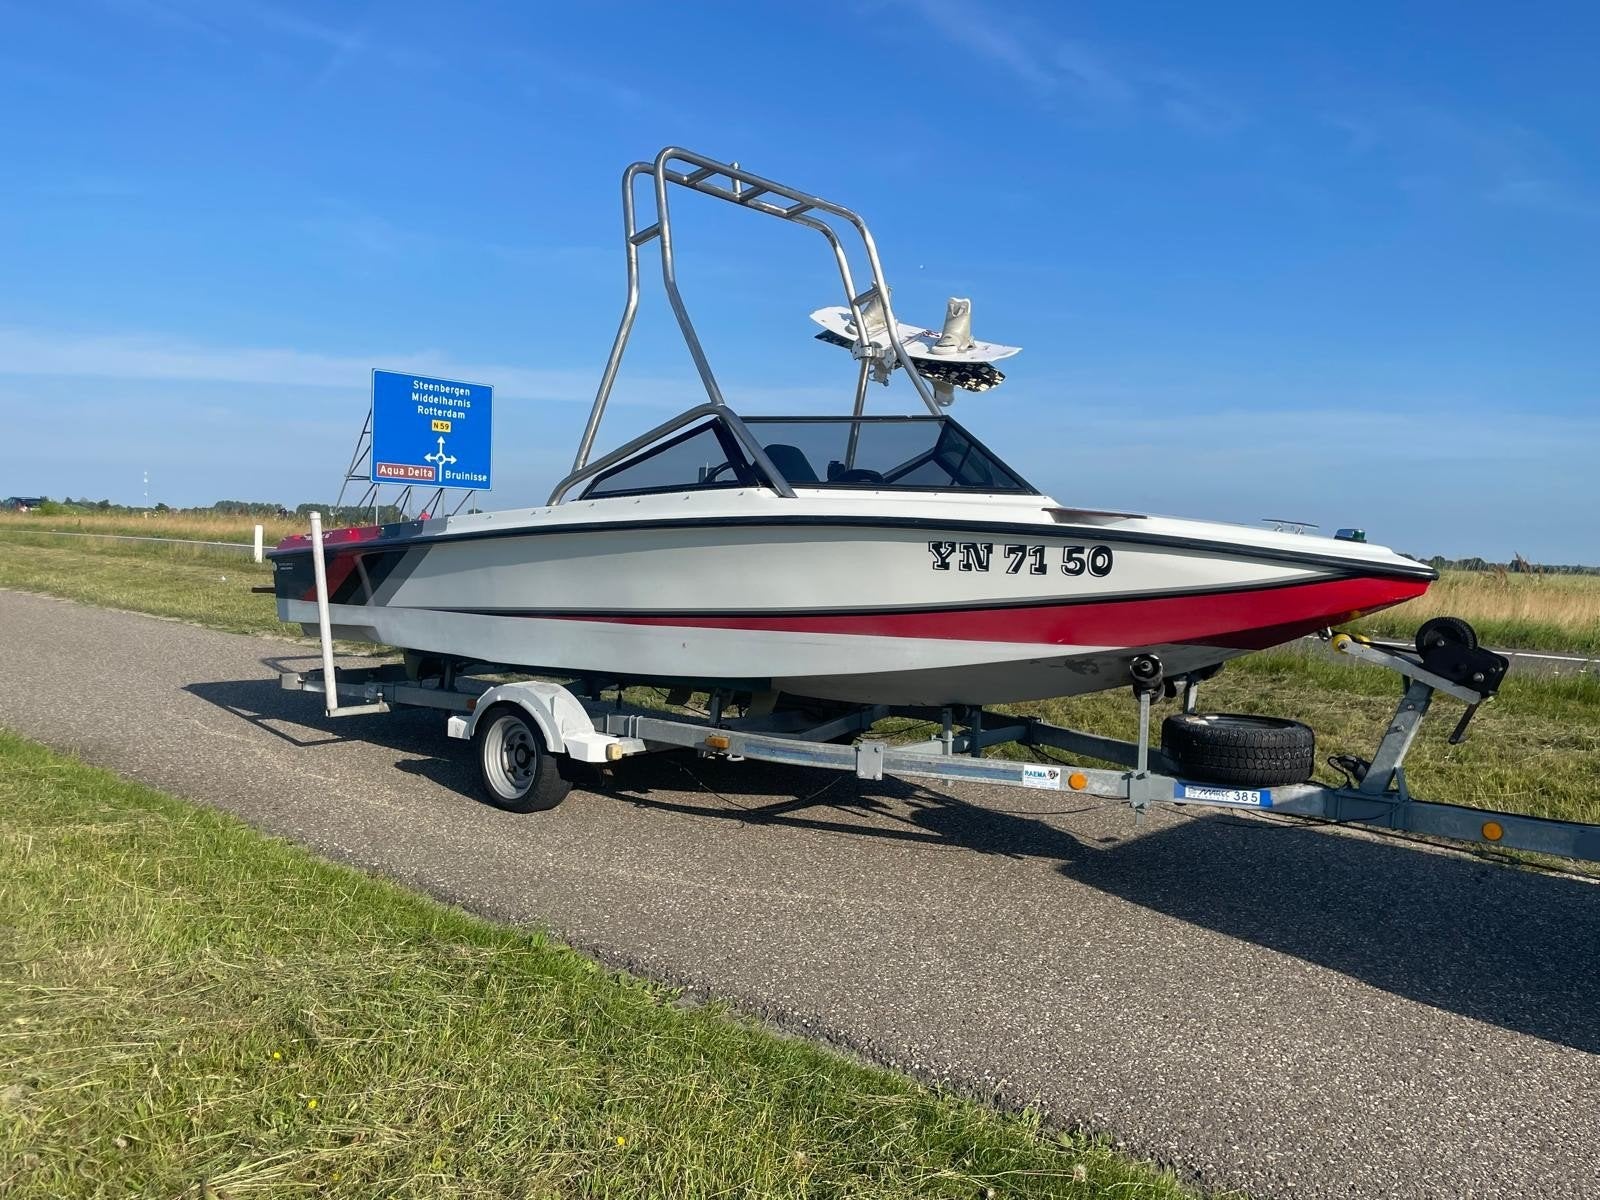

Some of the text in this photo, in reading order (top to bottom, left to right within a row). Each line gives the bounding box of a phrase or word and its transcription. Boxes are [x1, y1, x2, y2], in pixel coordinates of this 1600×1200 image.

[413, 380, 471, 397] Steenbergen
[411, 392, 471, 408] Middelharnis
[417, 405, 466, 419] Rotterdam
[379, 465, 433, 478] Aqua Delta
[445, 470, 487, 482] Bruinisse
[928, 540, 1114, 577] YN 71 50
[1233, 791, 1258, 803] 385
